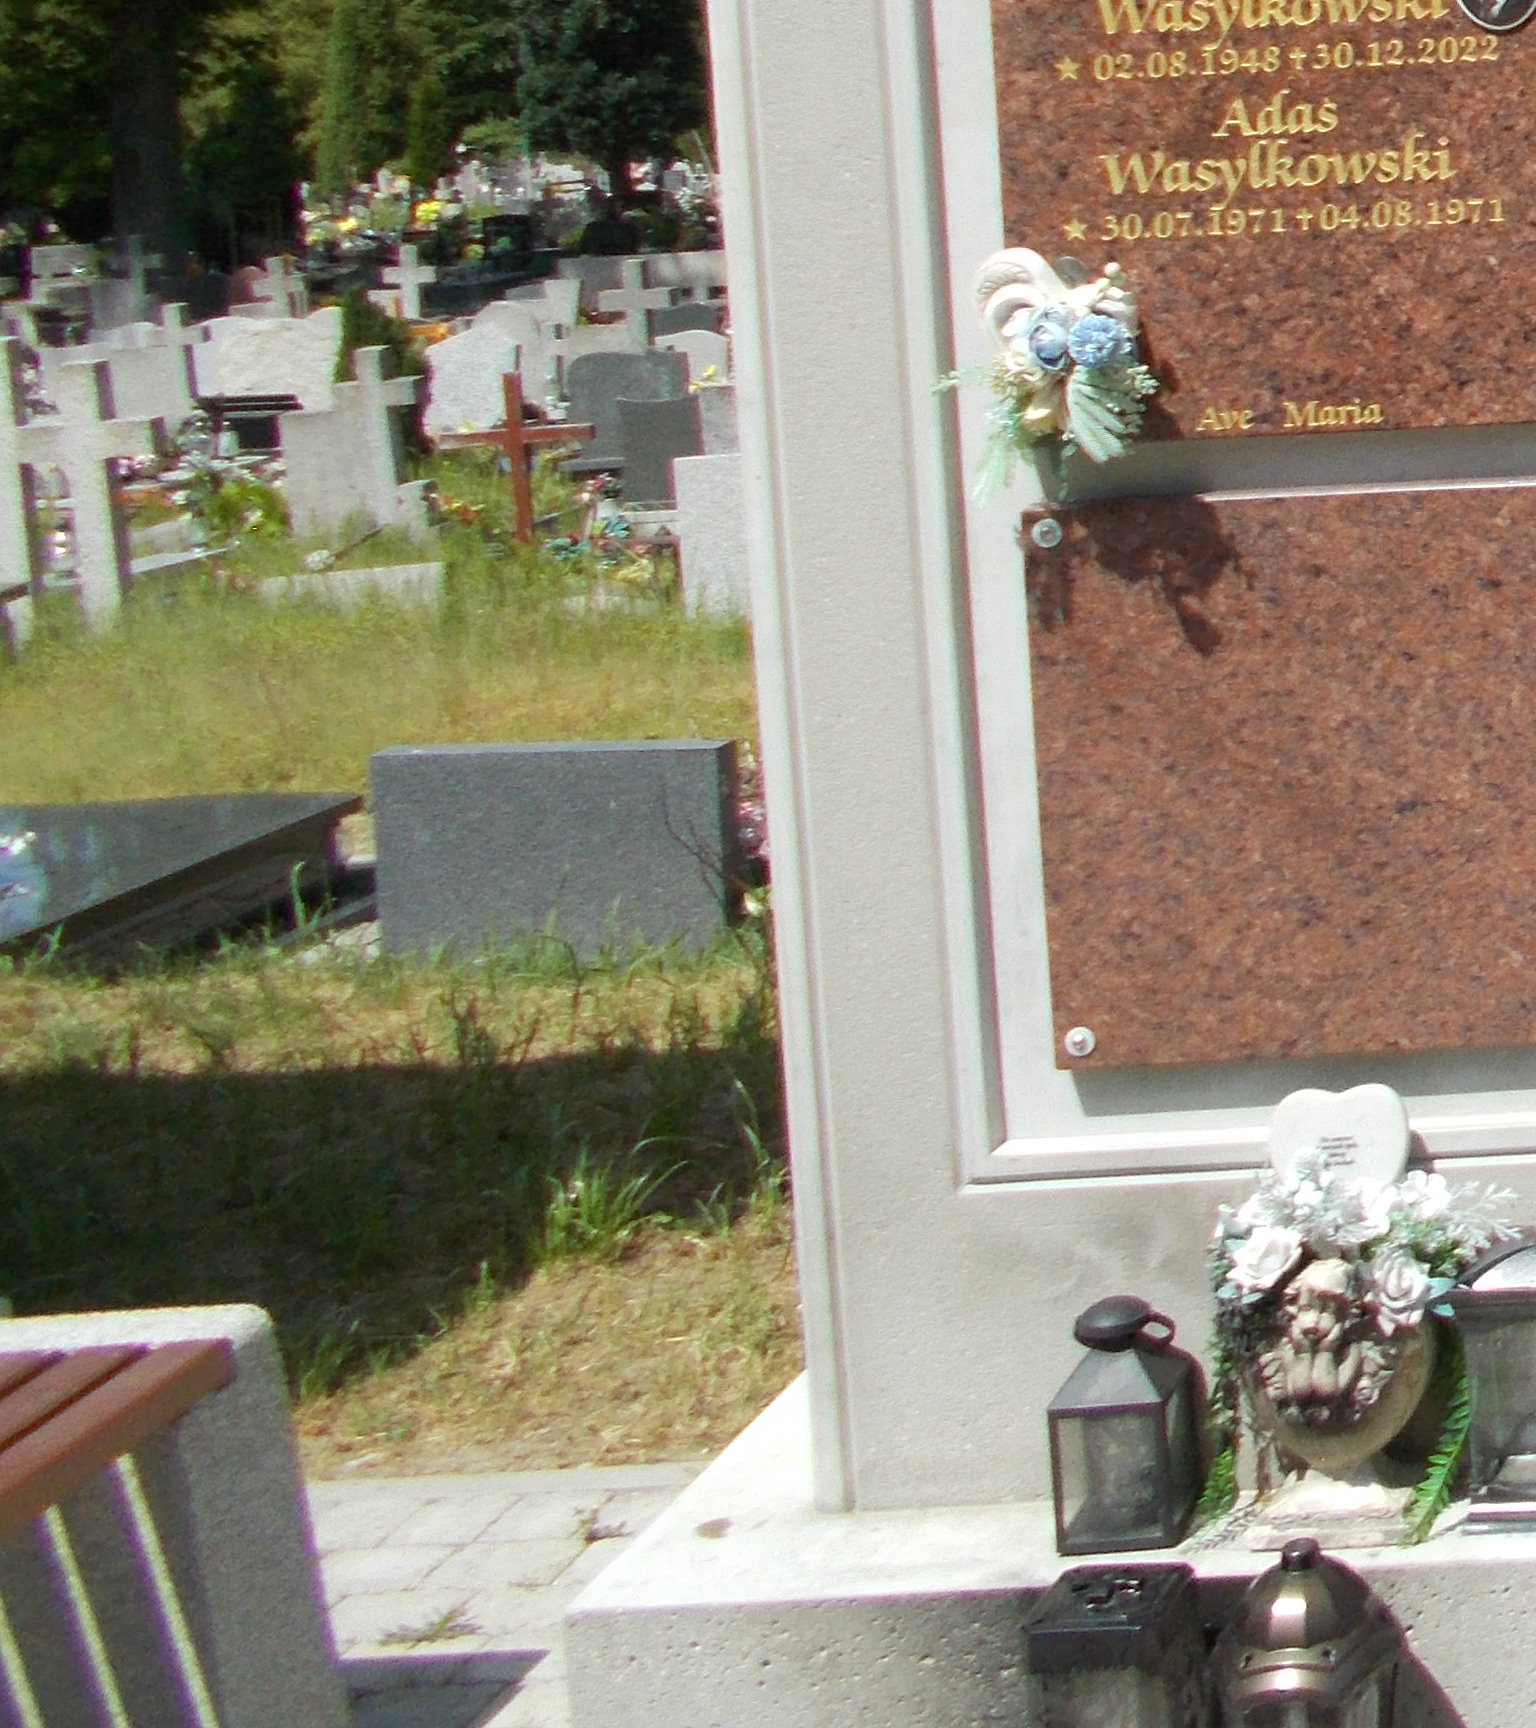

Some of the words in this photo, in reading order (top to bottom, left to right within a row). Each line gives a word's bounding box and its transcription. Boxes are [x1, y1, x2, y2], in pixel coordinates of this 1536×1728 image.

[1093, 45, 1280, 80] 02.08.1948
[1312, 35, 1499, 69] 30.12.2022
[1101, 132, 1457, 210] Wasylkowski
[1100, 207, 1287, 241] 30.07.1971
[1319, 198, 1505, 232] 04.08.1971
[1196, 406, 1254, 431] Ave
[1283, 398, 1384, 428] Maria
